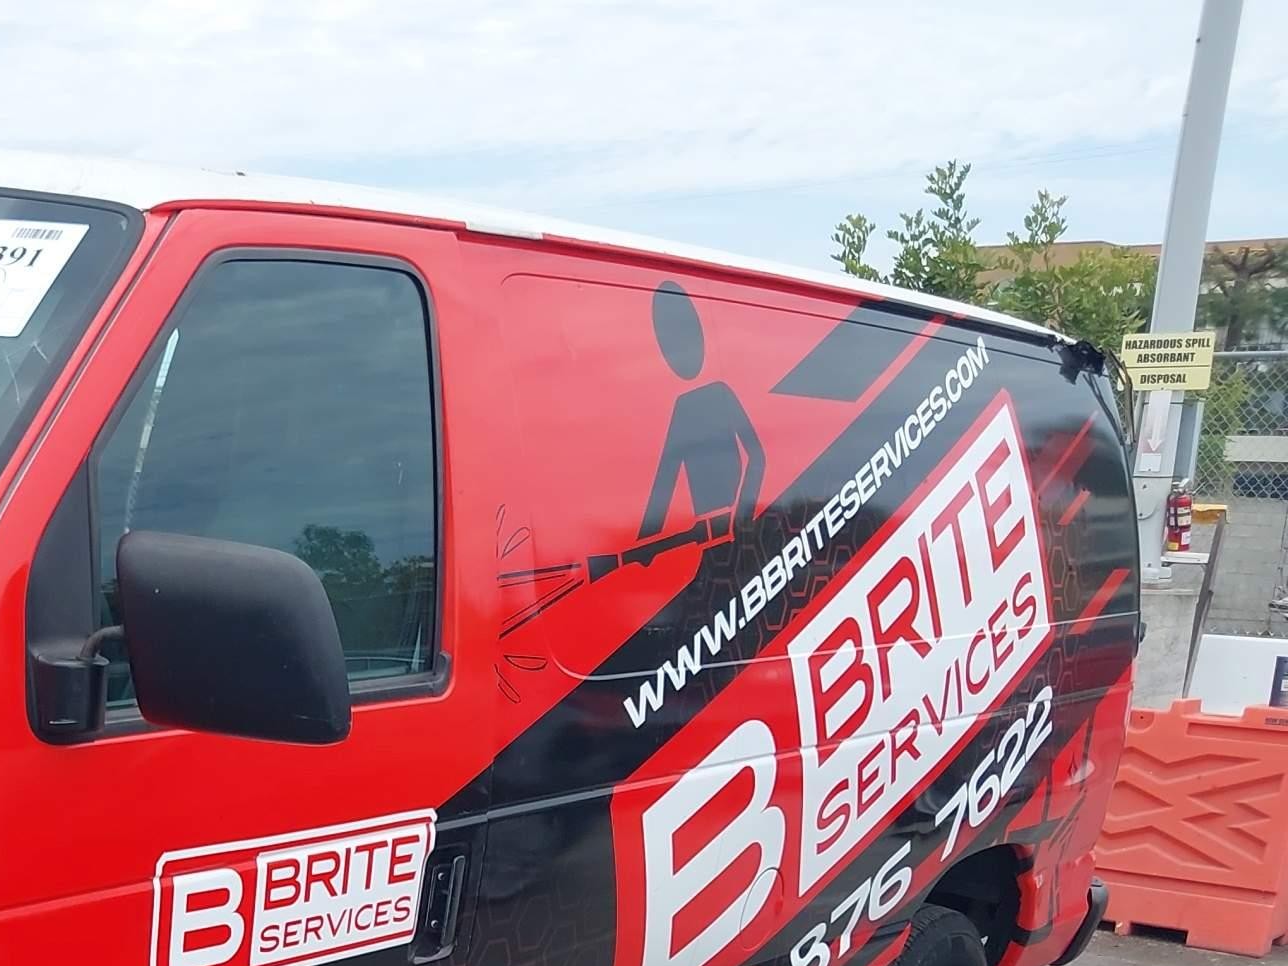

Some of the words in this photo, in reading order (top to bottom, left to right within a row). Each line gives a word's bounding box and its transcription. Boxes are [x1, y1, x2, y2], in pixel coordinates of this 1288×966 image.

[1125, 338, 1183, 350] HAZARDOUS
[1185, 338, 1211, 349] SPILL
[1137, 352, 1196, 364] ABSORBANT
[1140, 373, 1187, 385] DISPOSAL
[623, 337, 991, 728] WWW.BBRITESERVICES.COM
[807, 437, 1027, 743] BRITE
[817, 572, 1037, 852] SERVICES
[935, 685, 1053, 862] 7622
[264, 835, 420, 910] BRITE
[259, 896, 411, 953] SERVICES
